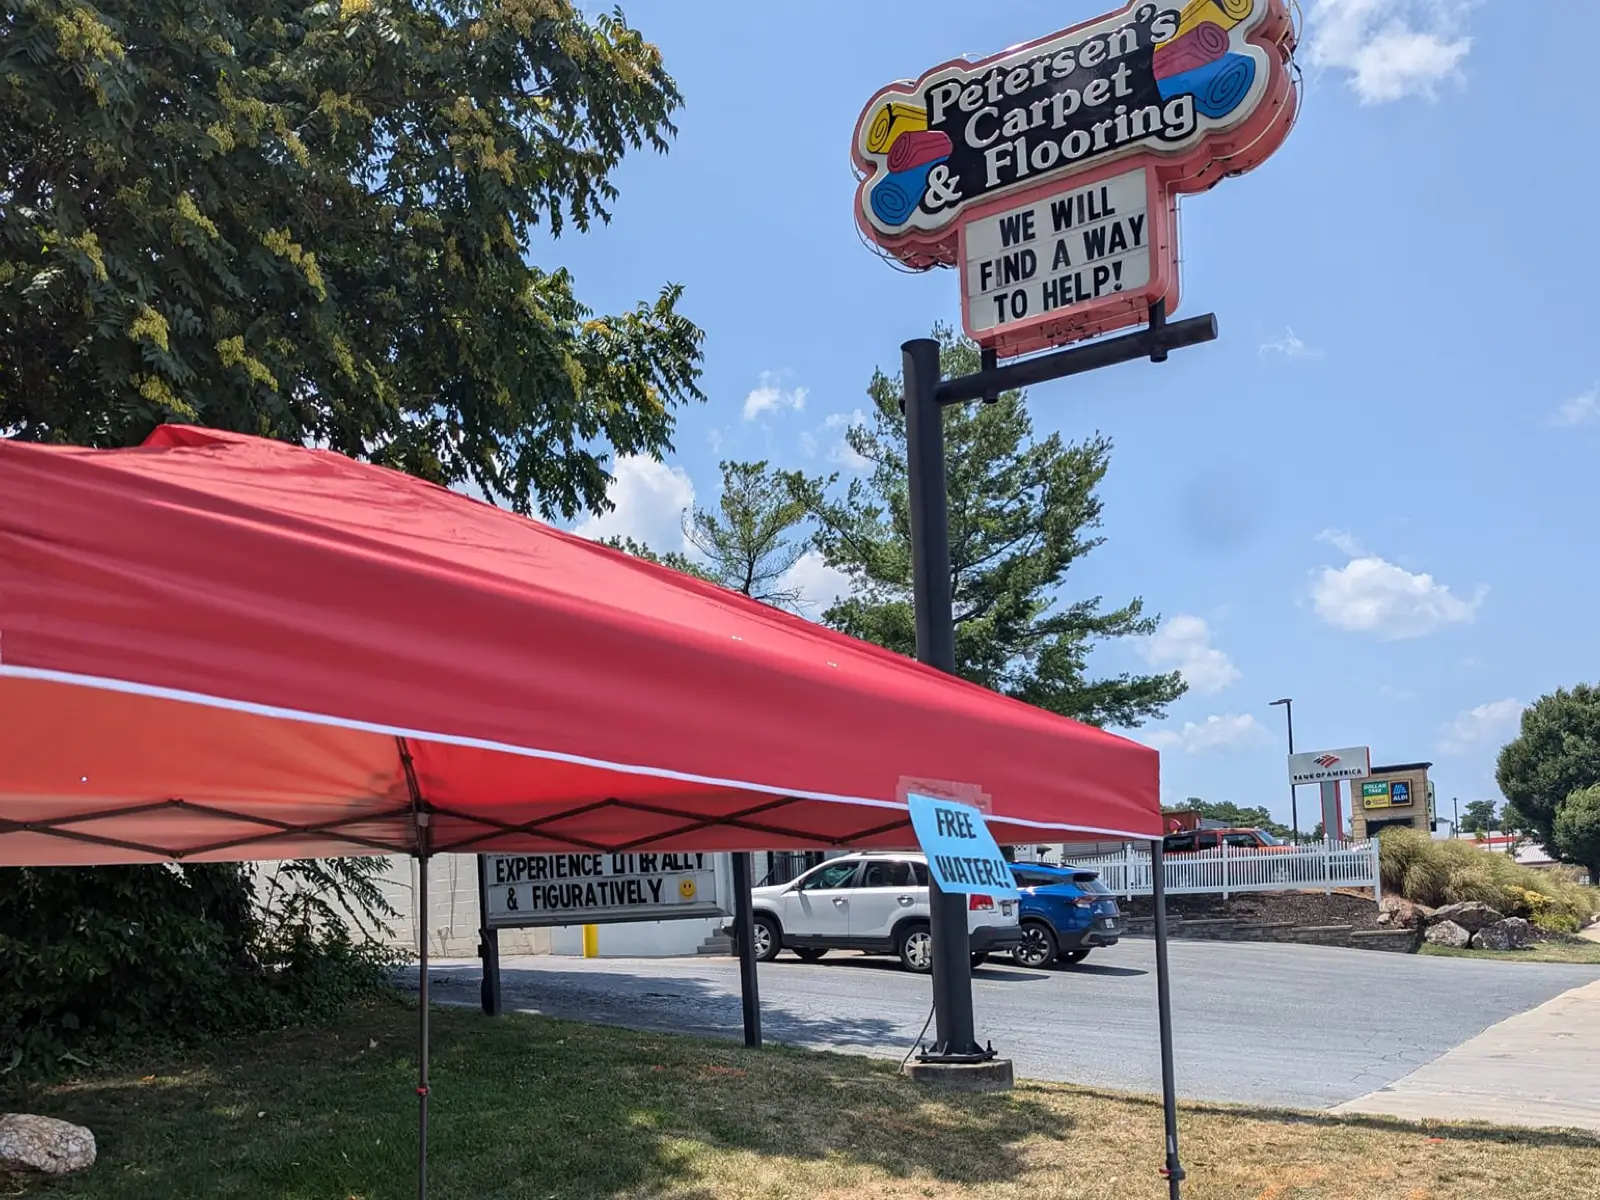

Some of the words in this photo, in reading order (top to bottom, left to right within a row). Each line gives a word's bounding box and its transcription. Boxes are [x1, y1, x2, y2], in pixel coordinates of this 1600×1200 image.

[930, 4, 1178, 126] Petersen's
[964, 63, 1133, 150] Carpet
[925, 165, 962, 209] &
[984, 95, 1194, 188] Flooring
[1000, 209, 1036, 247] WE
[1051, 187, 1116, 232] WILL
[980, 248, 1037, 292] FIND
[1052, 239, 1071, 271] A
[1083, 214, 1144, 261] WAY
[994, 289, 1028, 323] TO
[1043, 261, 1123, 312] HELP!
[935, 807, 977, 840] FREE
[496, 853, 603, 883] EXPERIENCE
[507, 887, 519, 911] &
[532, 878, 663, 910] FIGURATIVELY
[934, 854, 1012, 889] WATER!!
